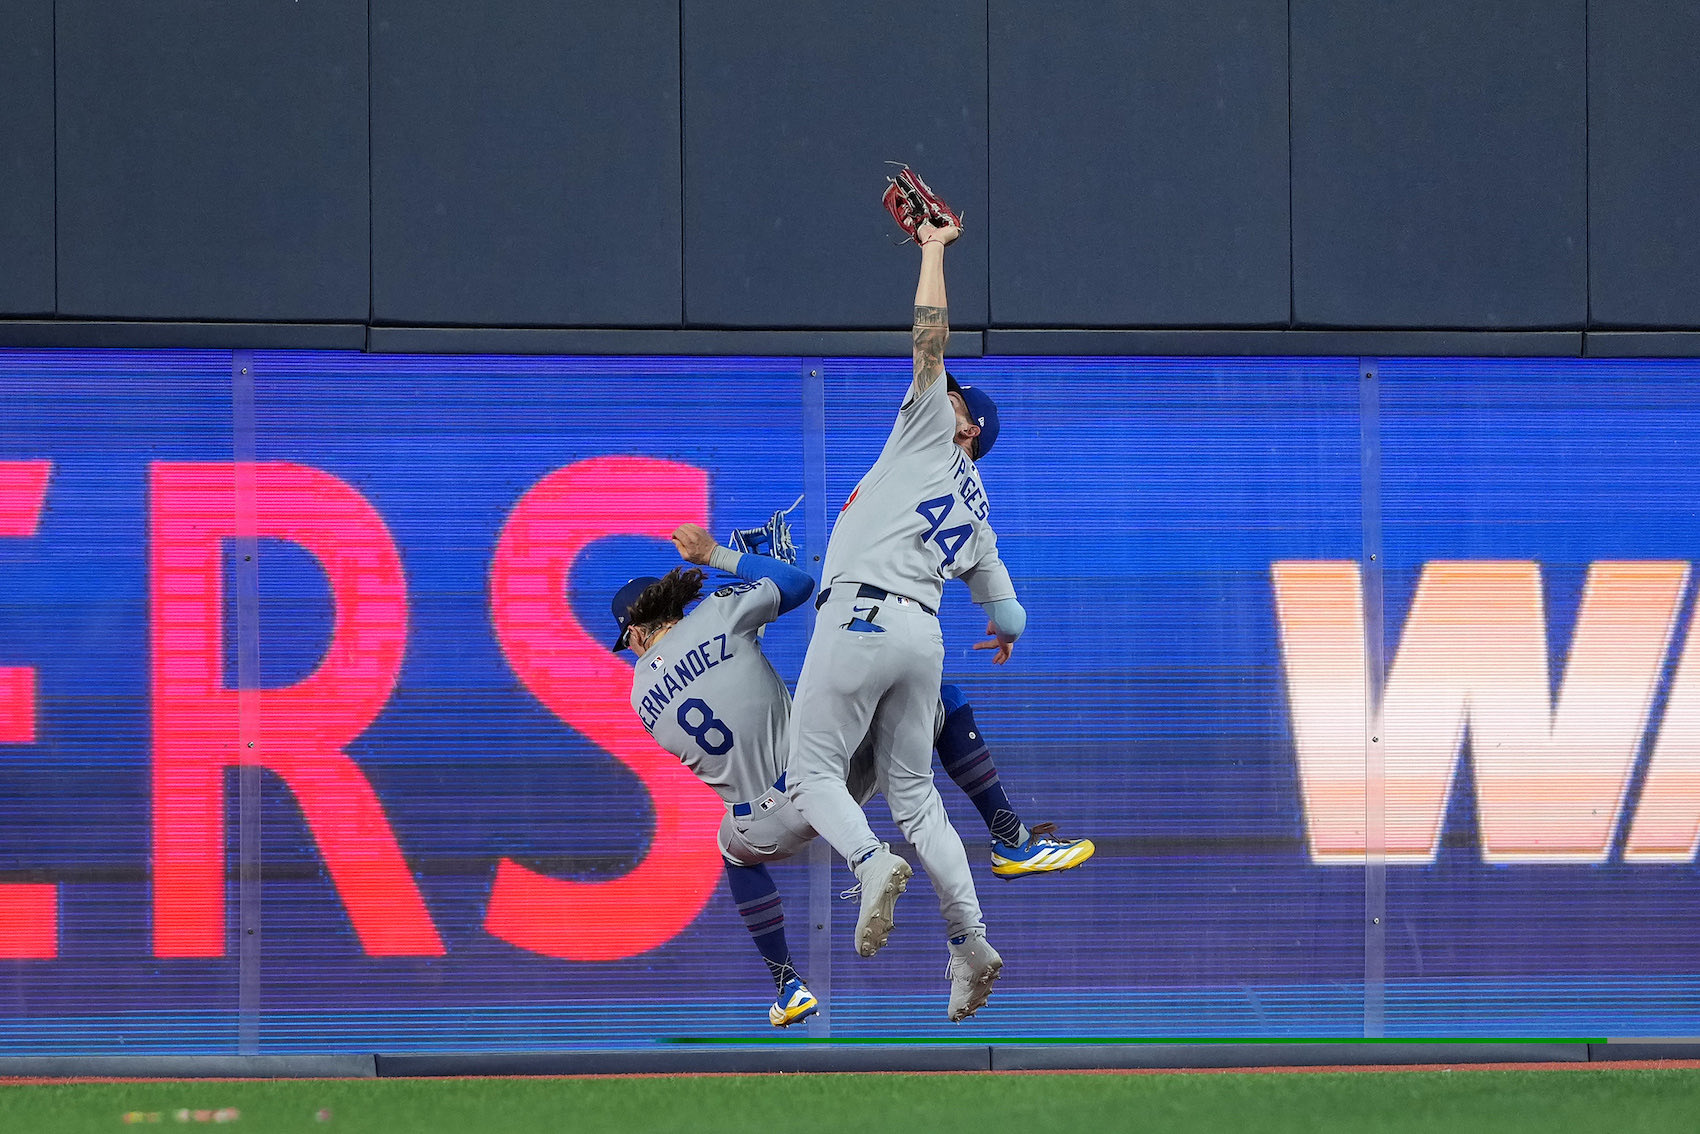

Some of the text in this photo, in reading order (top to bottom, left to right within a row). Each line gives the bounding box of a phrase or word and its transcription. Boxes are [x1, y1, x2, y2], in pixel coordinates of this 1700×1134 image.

[953, 457, 990, 521] PGES
[915, 493, 974, 579] 44
[638, 633, 734, 734] ERNÁNDEZ
[677, 698, 734, 755] 8
[1271, 560, 1700, 864] W
